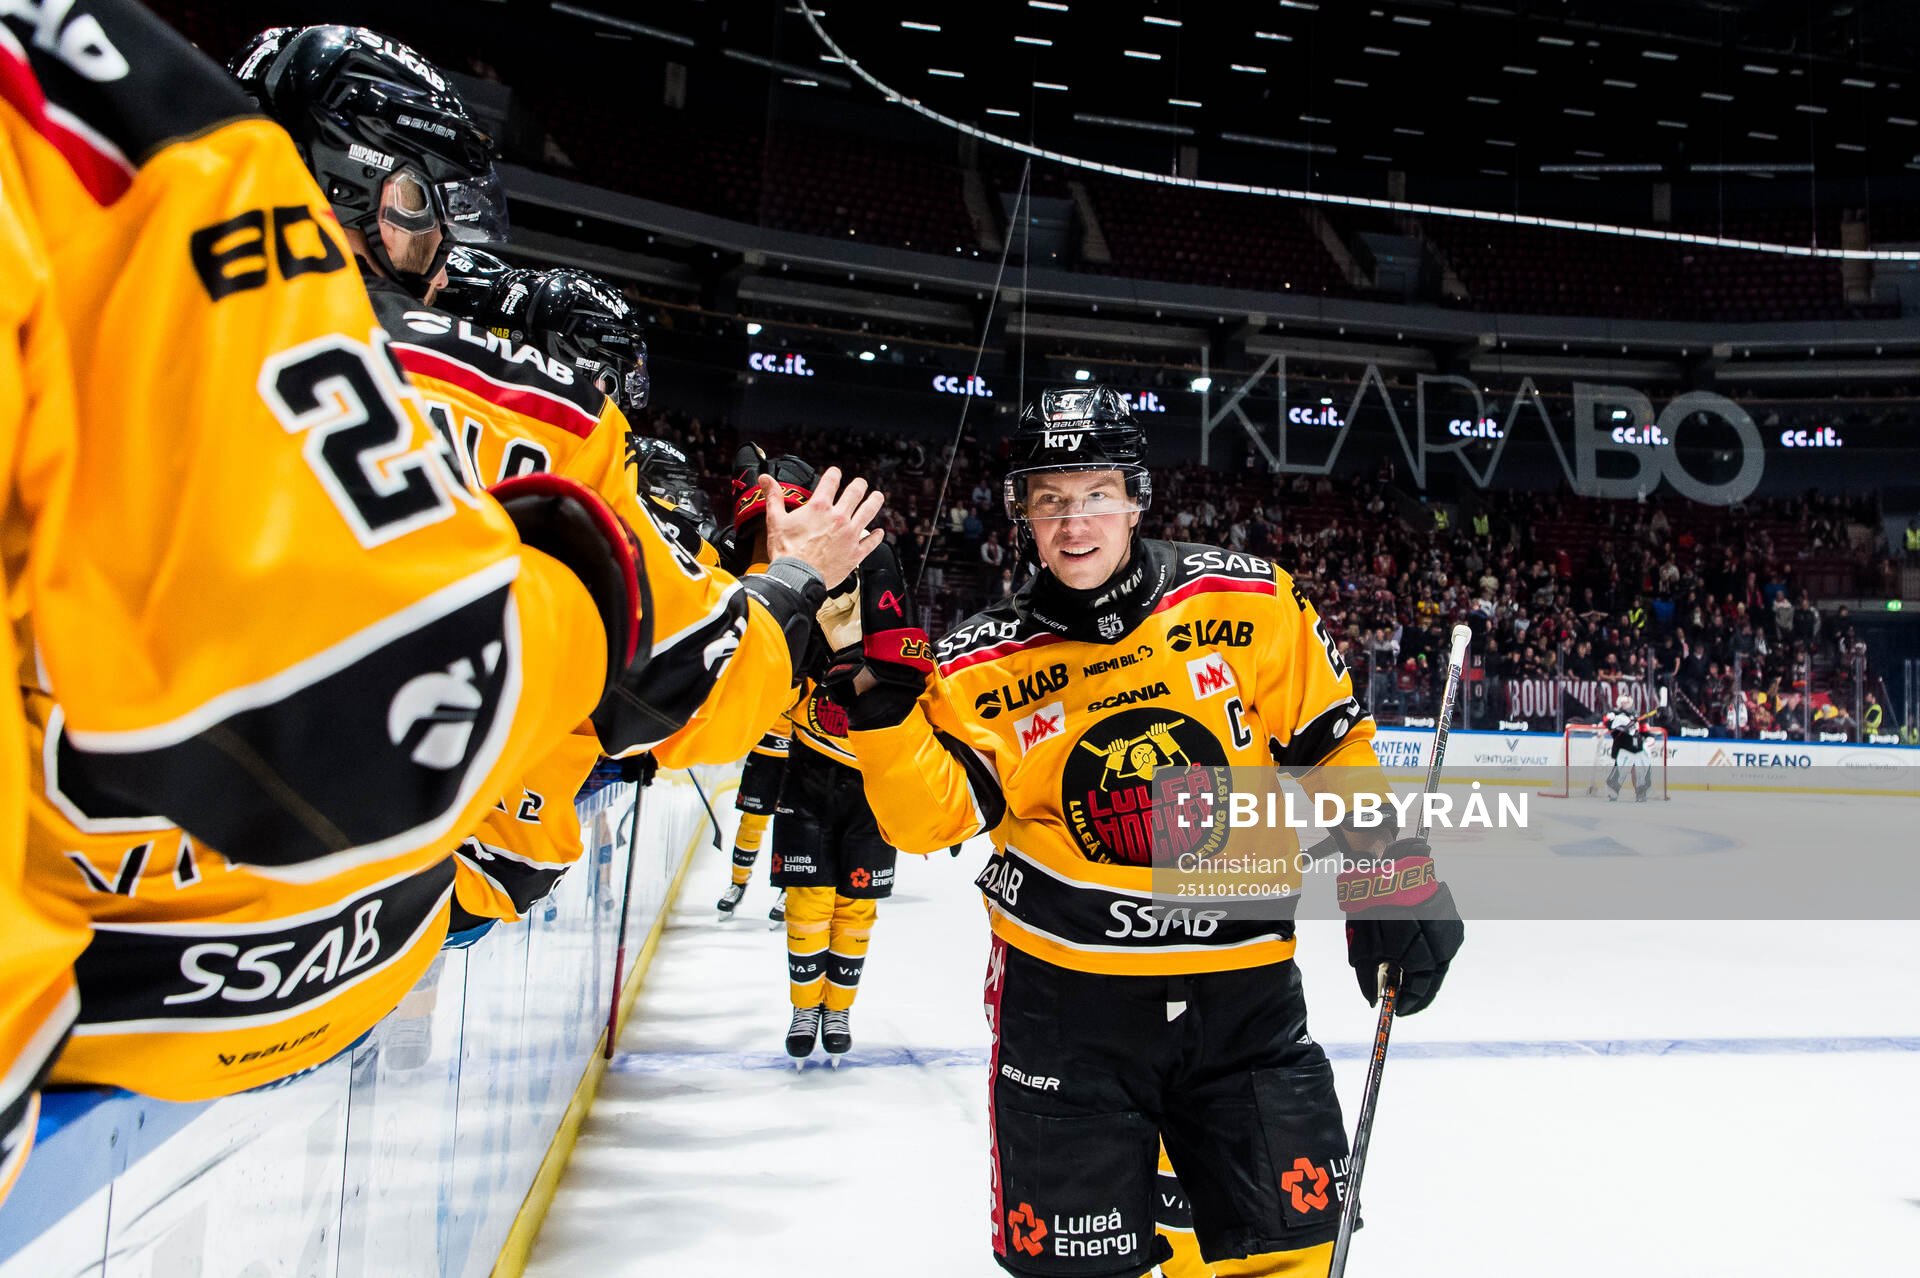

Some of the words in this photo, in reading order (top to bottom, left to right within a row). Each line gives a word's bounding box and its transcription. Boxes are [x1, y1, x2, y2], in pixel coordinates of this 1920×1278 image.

[383, 41, 446, 92] LKAB
[350, 143, 384, 166] IMPACT
[382, 152, 396, 171] BY
[749, 352, 814, 376] cc.it.
[933, 375, 993, 397] cc.it.
[1289, 406, 1345, 427] cc.it.
[1449, 418, 1504, 438] cc.it.
[1044, 431, 1083, 452] kry
[1612, 425, 1669, 445] cc.it.
[1781, 427, 1843, 447] cc.it.
[1183, 551, 1273, 576] SSAB
[936, 619, 1021, 658] SSAB
[1195, 619, 1254, 647] LKAB
[1083, 658, 1119, 679] NIEMI
[1002, 663, 1070, 712] LKAB
[1087, 681, 1171, 713] SCANIA
[1224, 696, 1252, 751] C
[1733, 752, 1812, 769] TREANO
[1088, 762, 1212, 818] LULEÅ
[1069, 800, 1100, 856] LULEÅ
[1093, 798, 1212, 864] HOCKEY
[784, 854, 812, 863] Luleå
[784, 863, 817, 874] Energi
[1105, 899, 1228, 938] SSAB
[164, 899, 384, 1006] SSAB
[1001, 1063, 1060, 1091] BAUER
[1054, 1207, 1122, 1234] Luleå
[1054, 1232, 1137, 1257] Energi
